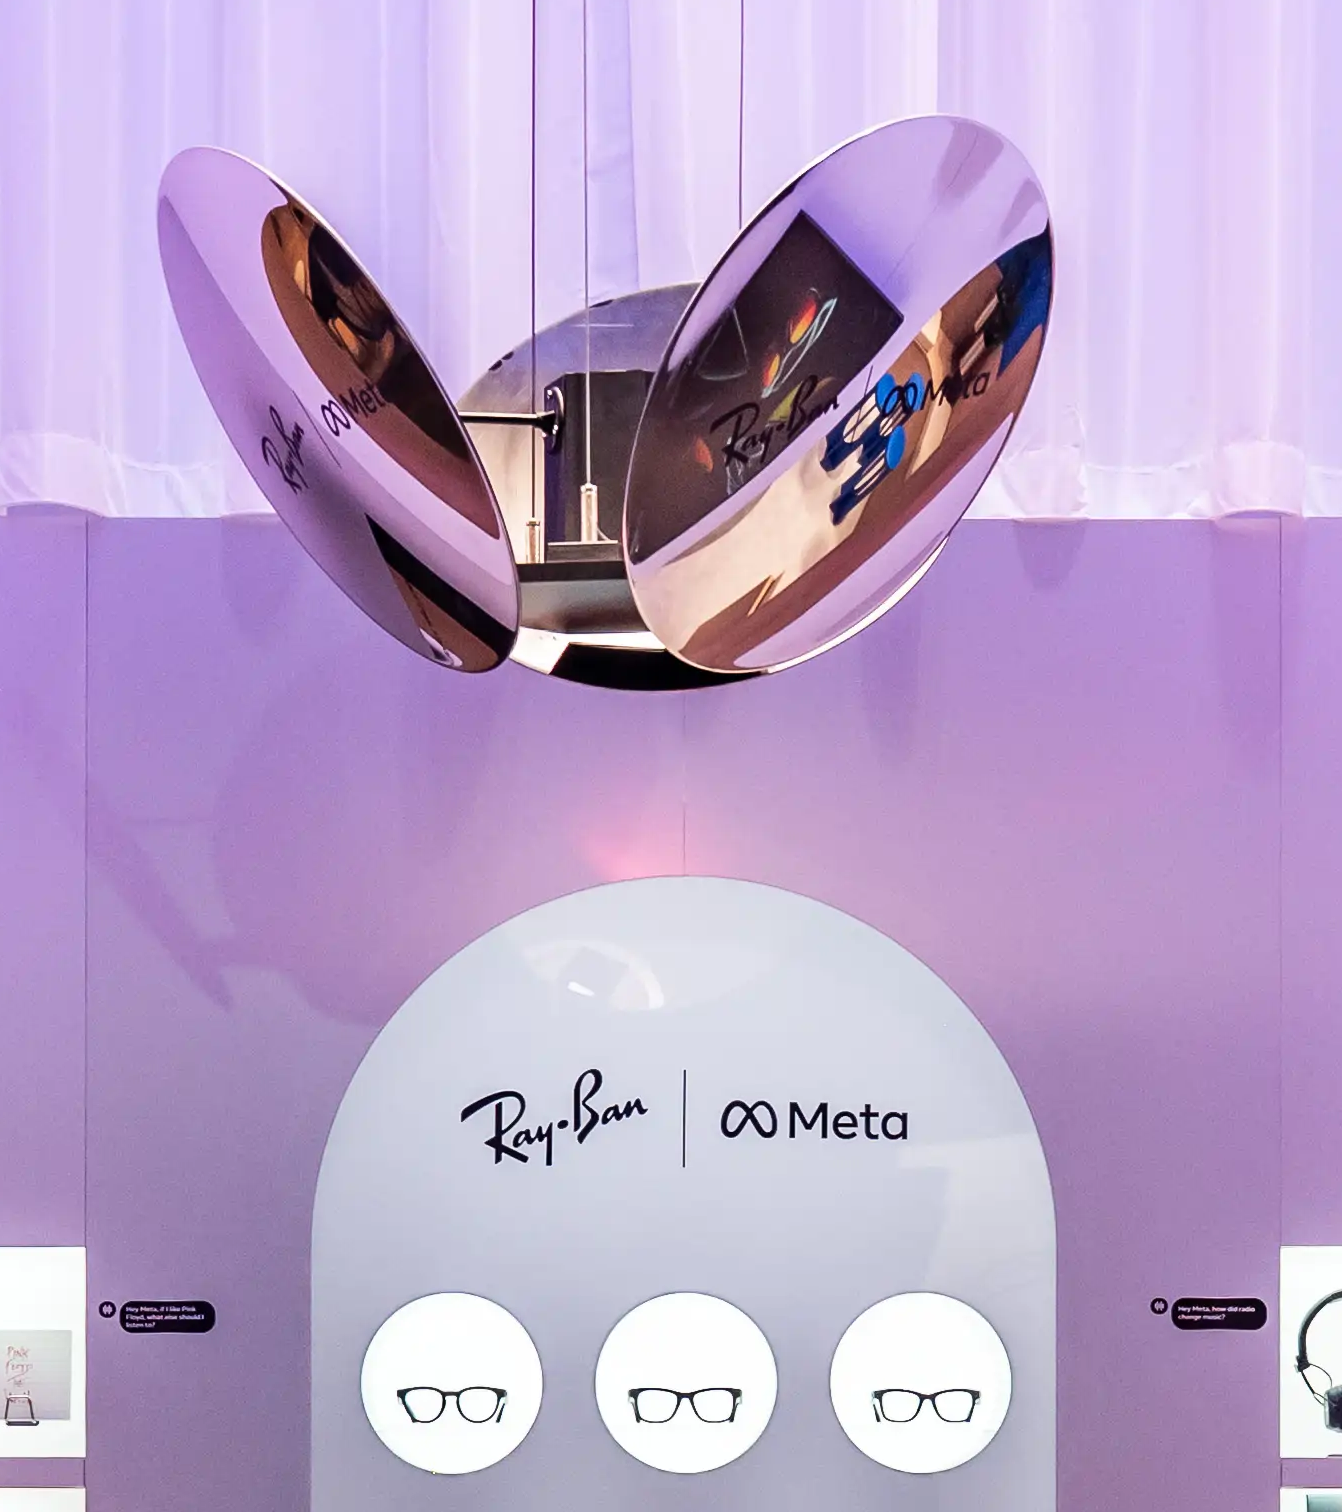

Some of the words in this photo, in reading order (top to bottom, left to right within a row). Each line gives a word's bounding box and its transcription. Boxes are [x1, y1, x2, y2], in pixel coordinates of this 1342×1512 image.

[339, 379, 388, 421] Met
[921, 371, 990, 410] Mta
[788, 1101, 908, 1140] Meta
